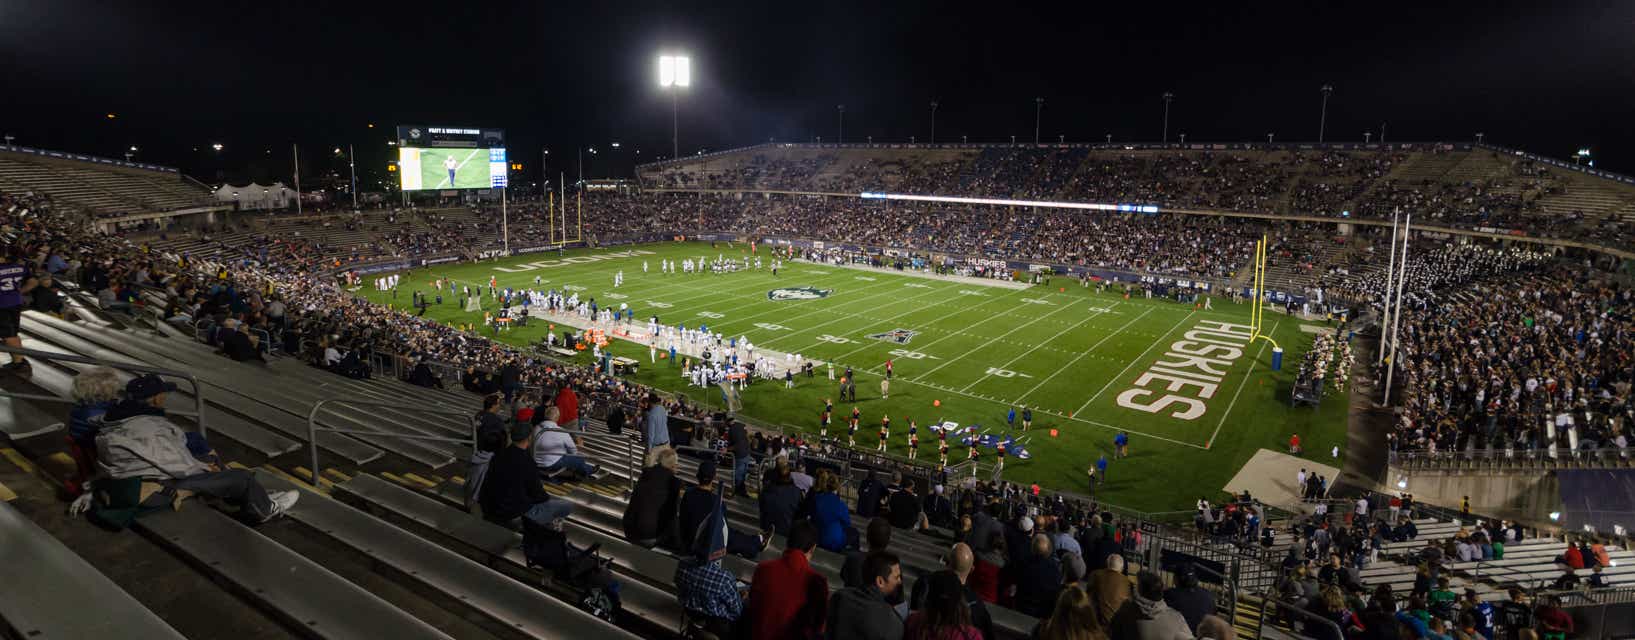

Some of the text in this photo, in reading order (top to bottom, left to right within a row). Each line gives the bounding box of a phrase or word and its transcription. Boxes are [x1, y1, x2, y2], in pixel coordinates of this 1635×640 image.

[816, 334, 849, 344] 30
[888, 349, 927, 359] 20
[985, 366, 1017, 378] 10
[1116, 320, 1257, 420] HUSKIES
